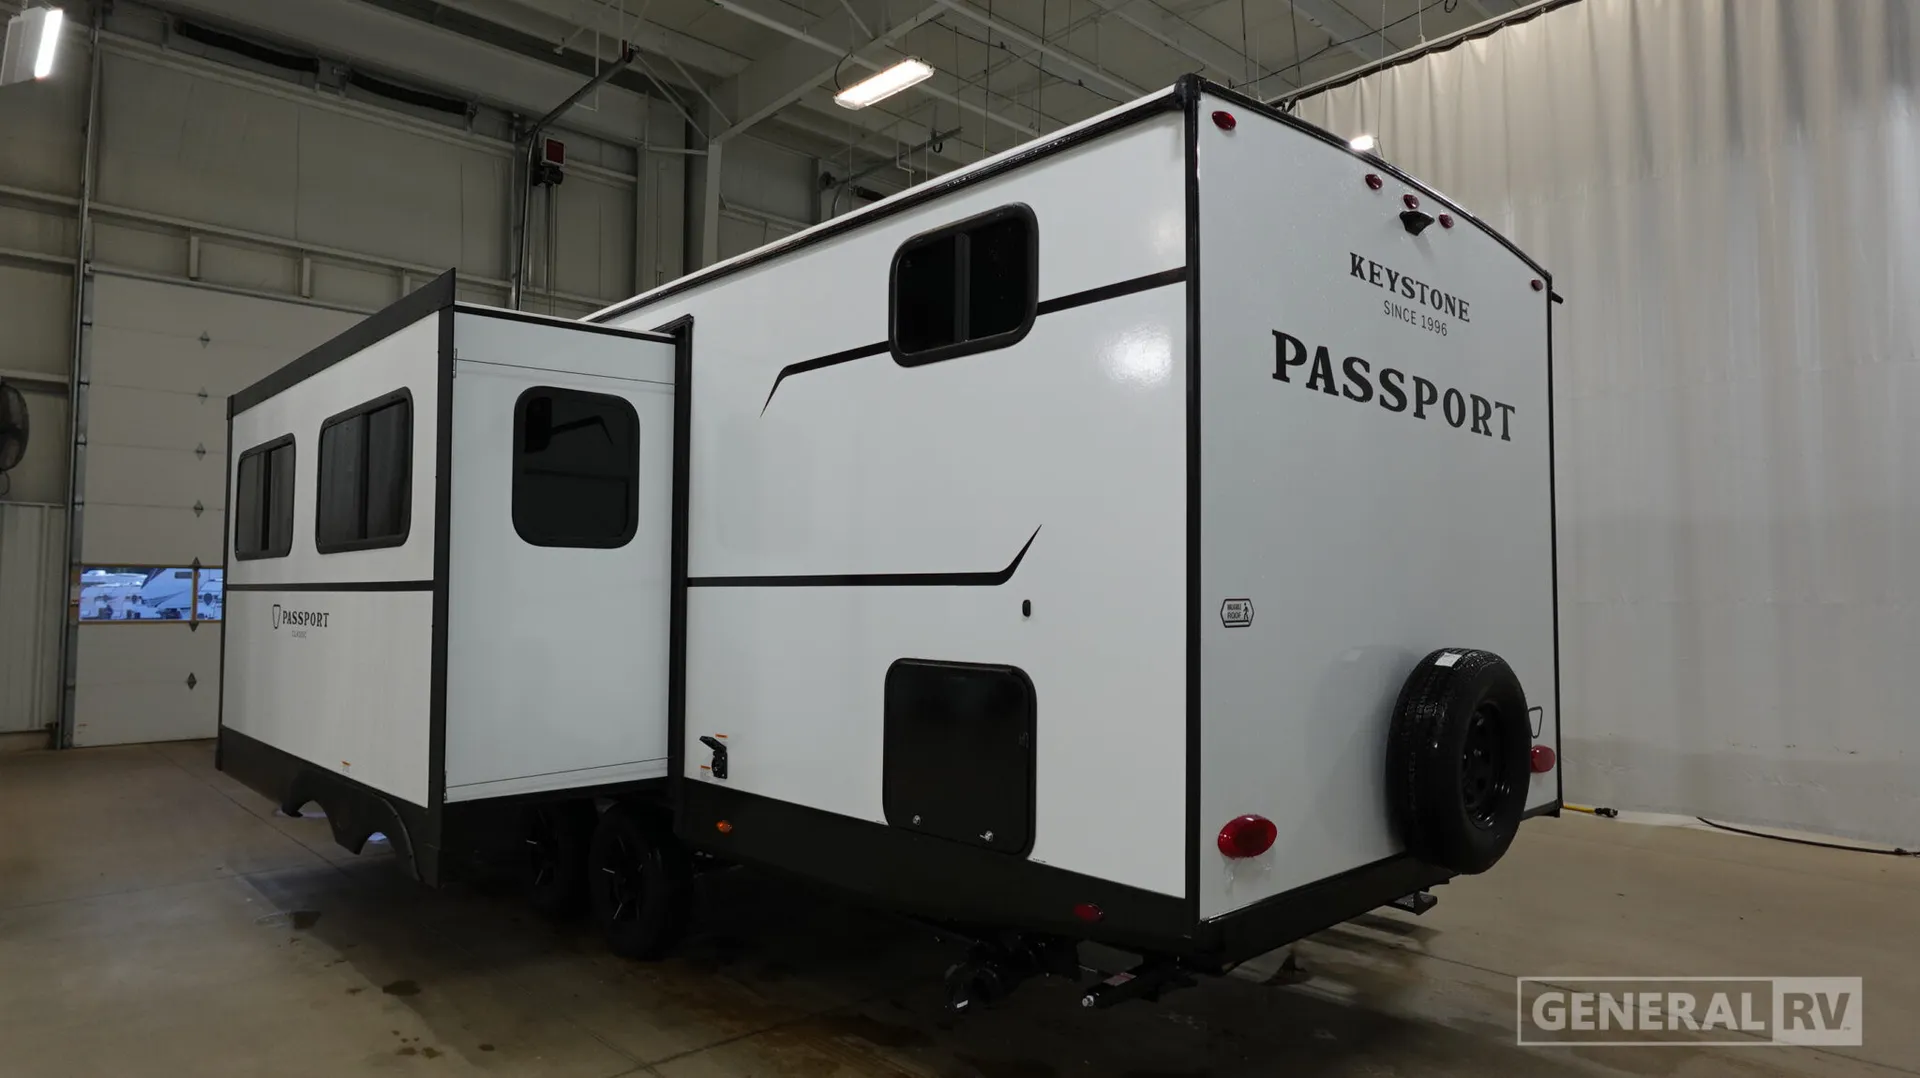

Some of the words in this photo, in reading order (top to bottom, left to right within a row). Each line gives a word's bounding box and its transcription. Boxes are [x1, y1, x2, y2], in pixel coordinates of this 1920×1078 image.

[1349, 252, 1471, 323] KEYSTONE
[1383, 300, 1417, 326] SINCE
[1421, 314, 1448, 337] 1996
[1272, 329, 1516, 442] PASSPORT
[282, 610, 330, 628] PASSPORT
